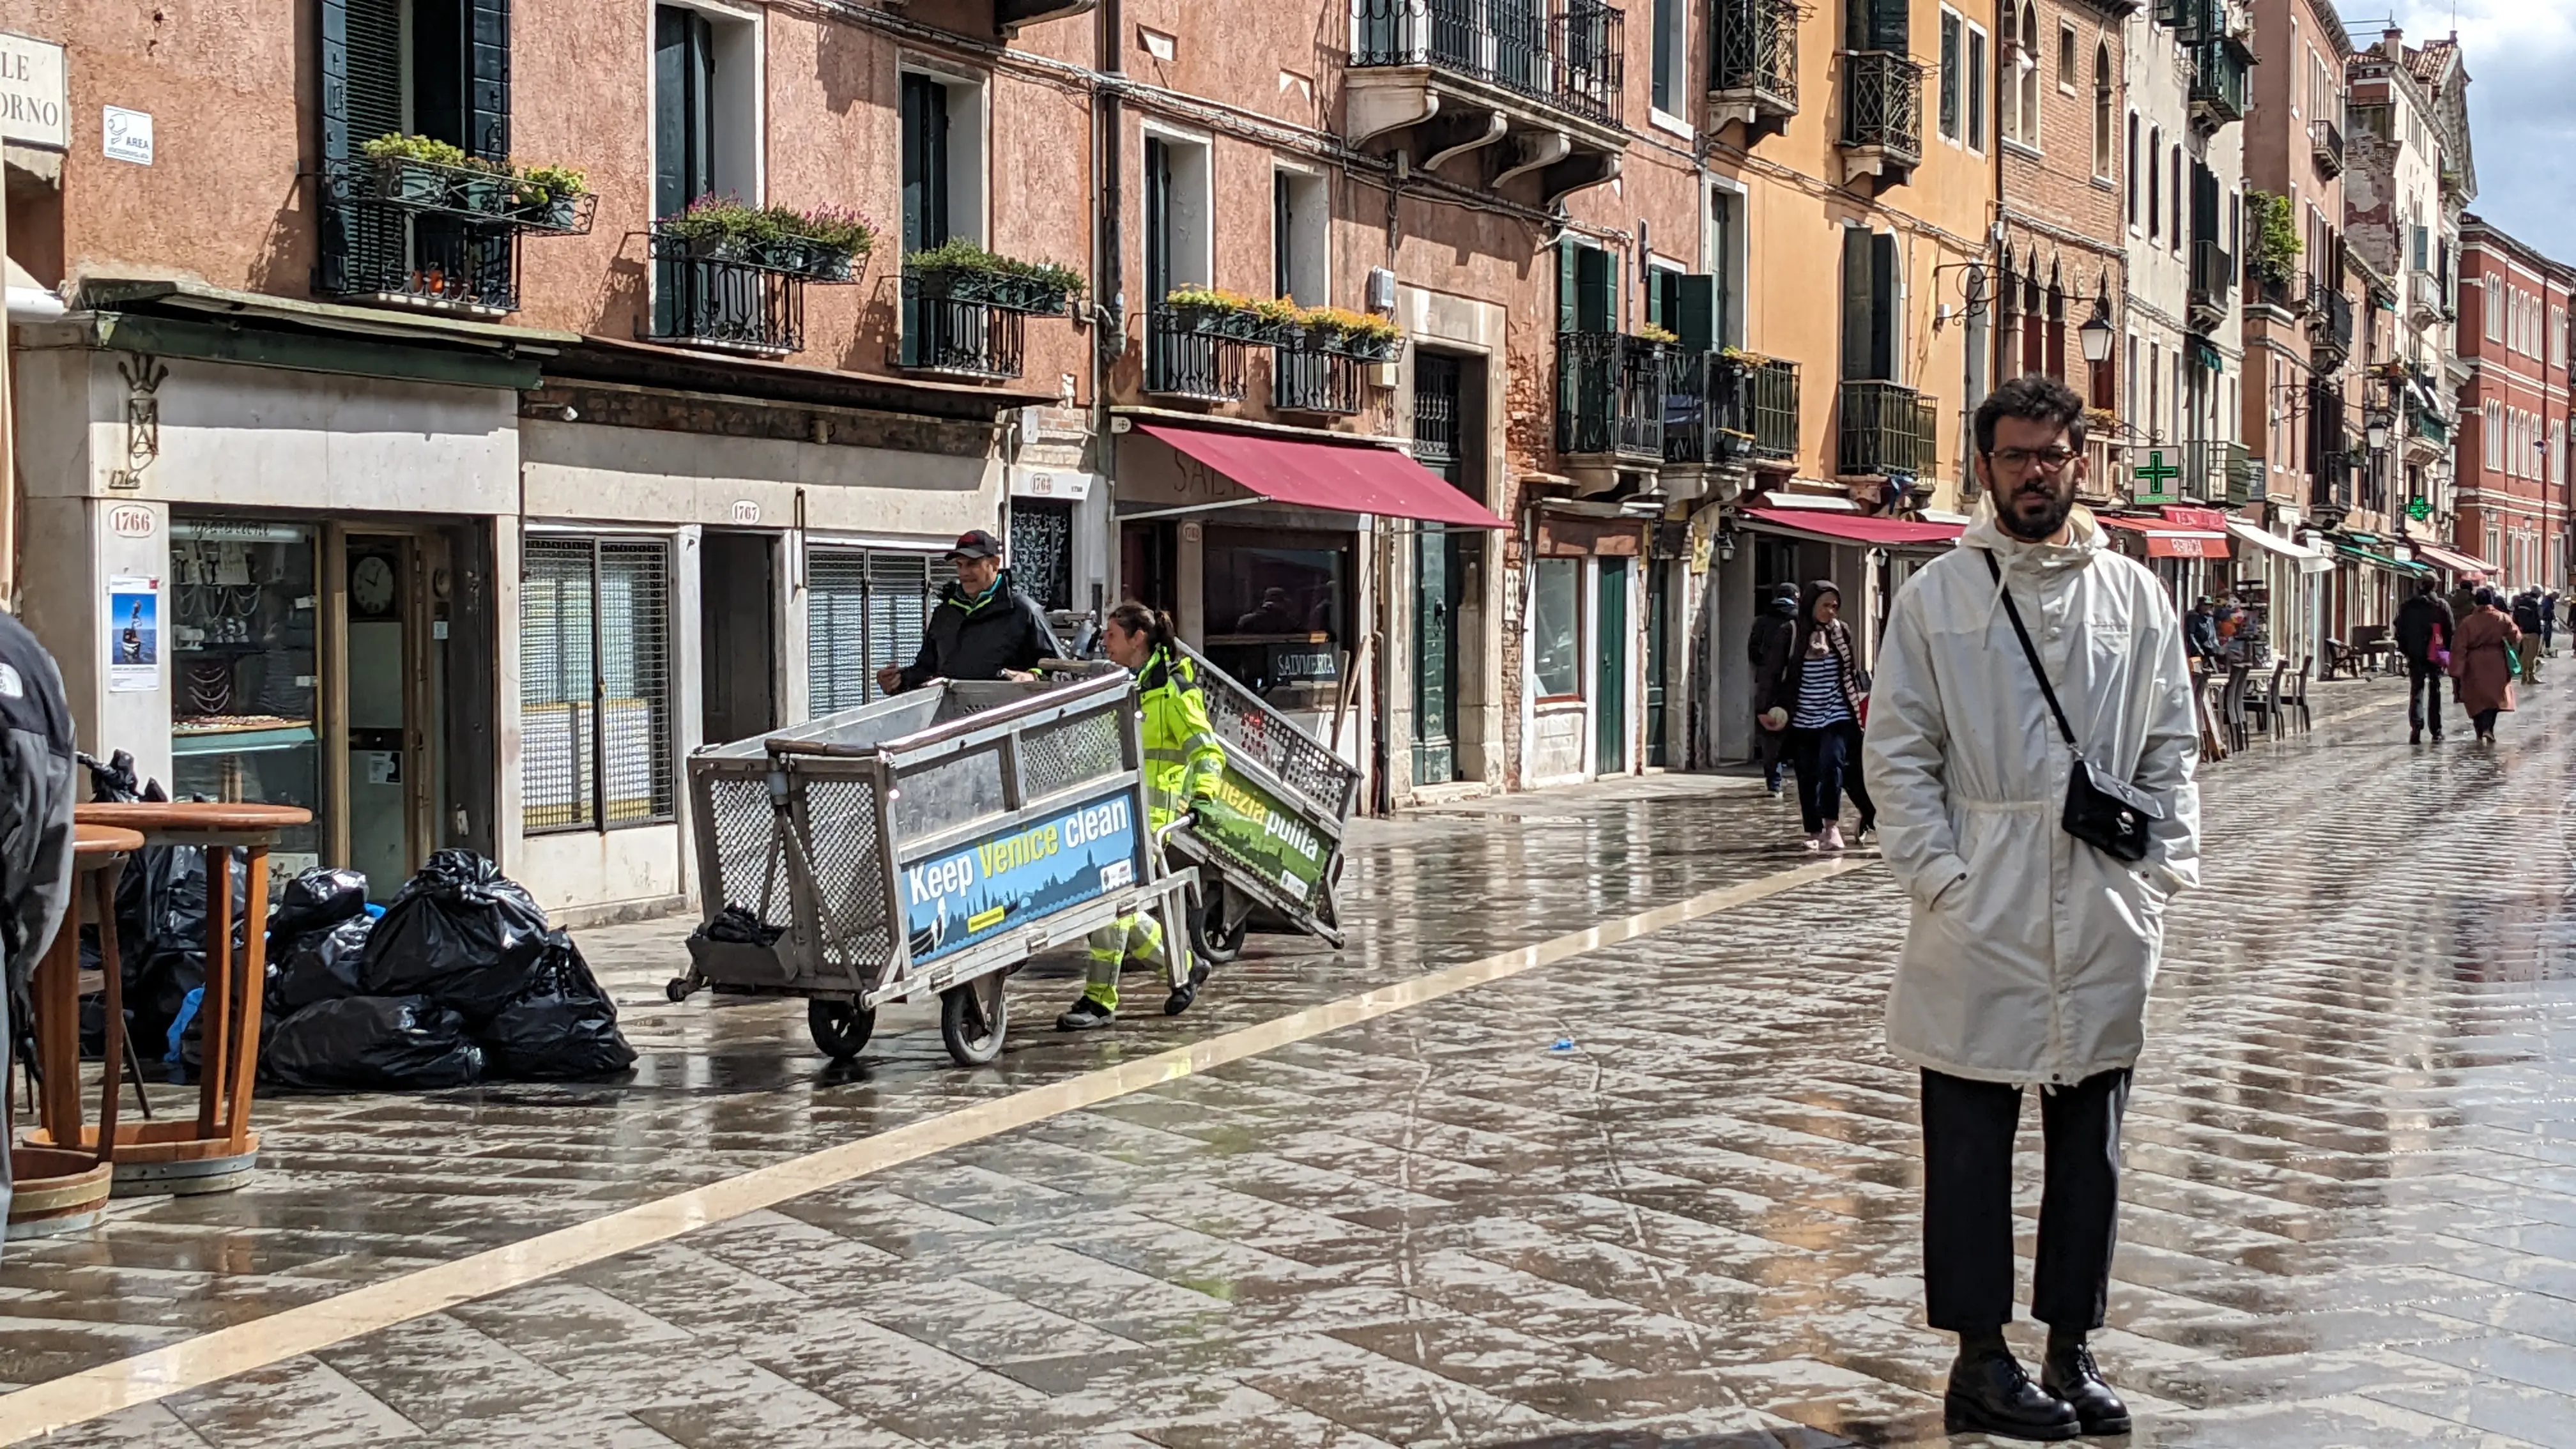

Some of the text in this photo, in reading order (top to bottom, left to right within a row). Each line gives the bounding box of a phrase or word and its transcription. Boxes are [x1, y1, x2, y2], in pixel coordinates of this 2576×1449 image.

[126, 136, 150, 150] AREA
[1174, 448, 1236, 496] SAL
[115, 512, 150, 532] 1766
[734, 504, 757, 521] 1767
[909, 799, 1128, 905] Keep Venice clean
[1264, 809, 1319, 862] pulita
